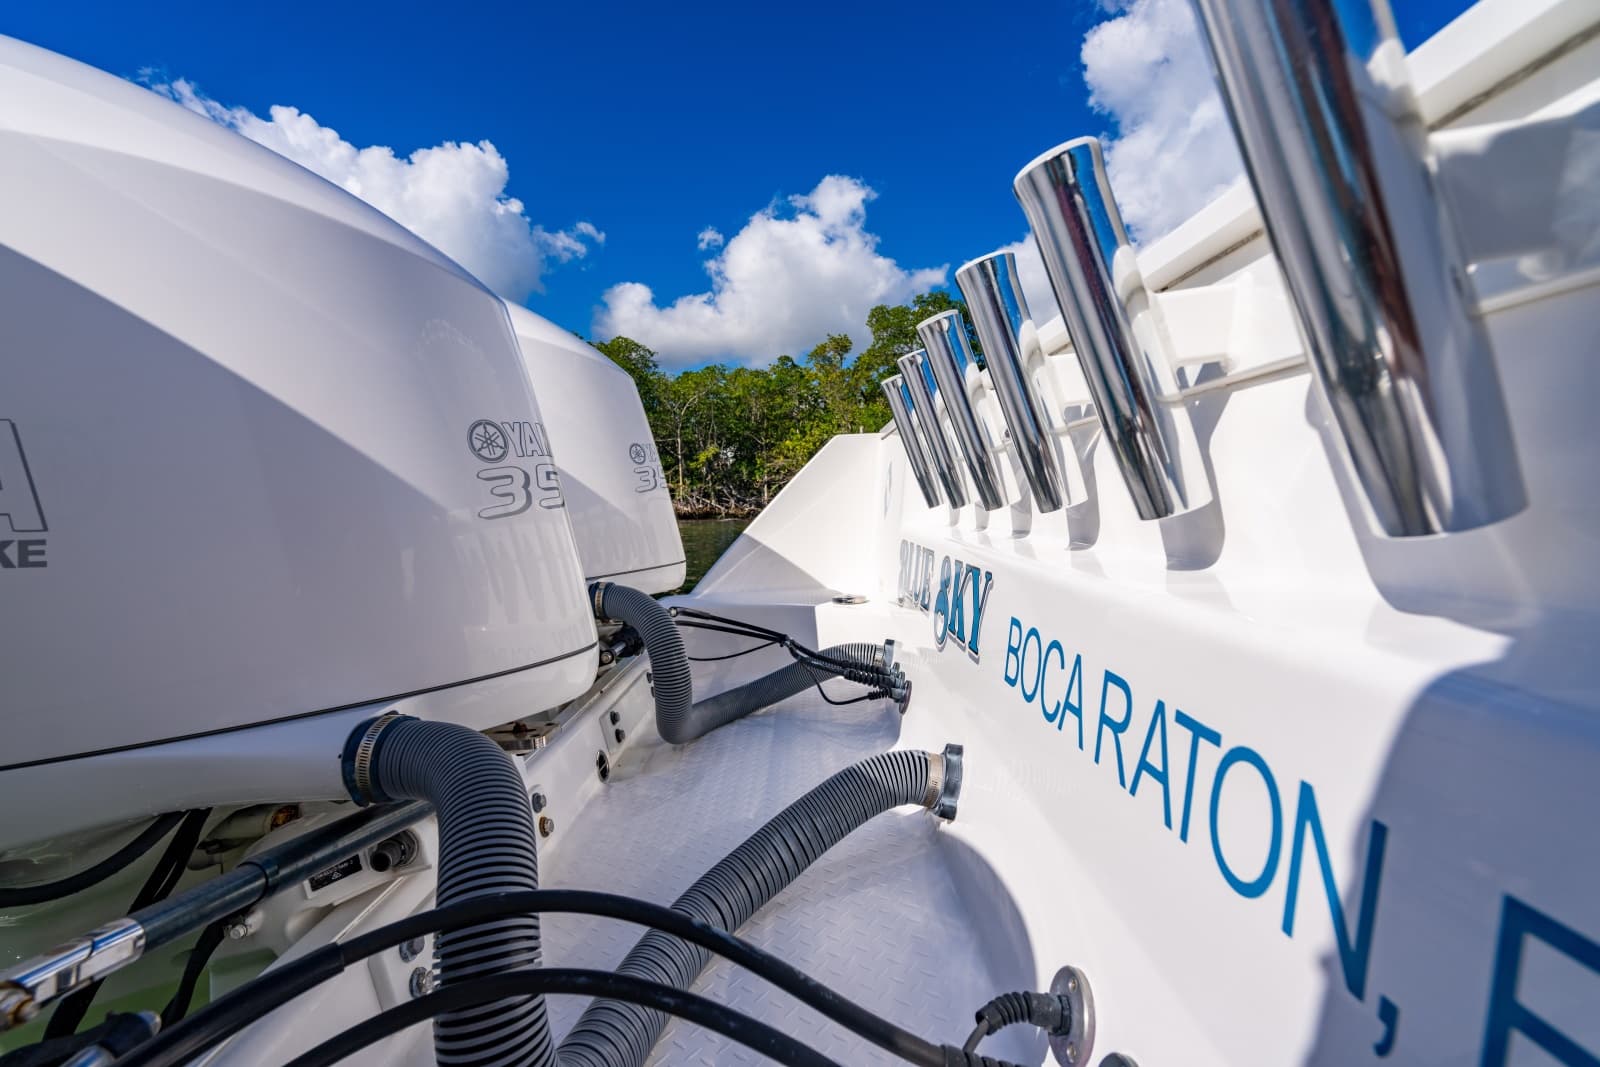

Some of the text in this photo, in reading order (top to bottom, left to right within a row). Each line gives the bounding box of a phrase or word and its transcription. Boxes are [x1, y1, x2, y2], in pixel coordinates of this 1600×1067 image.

[933, 555, 994, 665] SKY
[1004, 616, 1084, 752] BOCA
[1093, 668, 1399, 1058] RATON,
